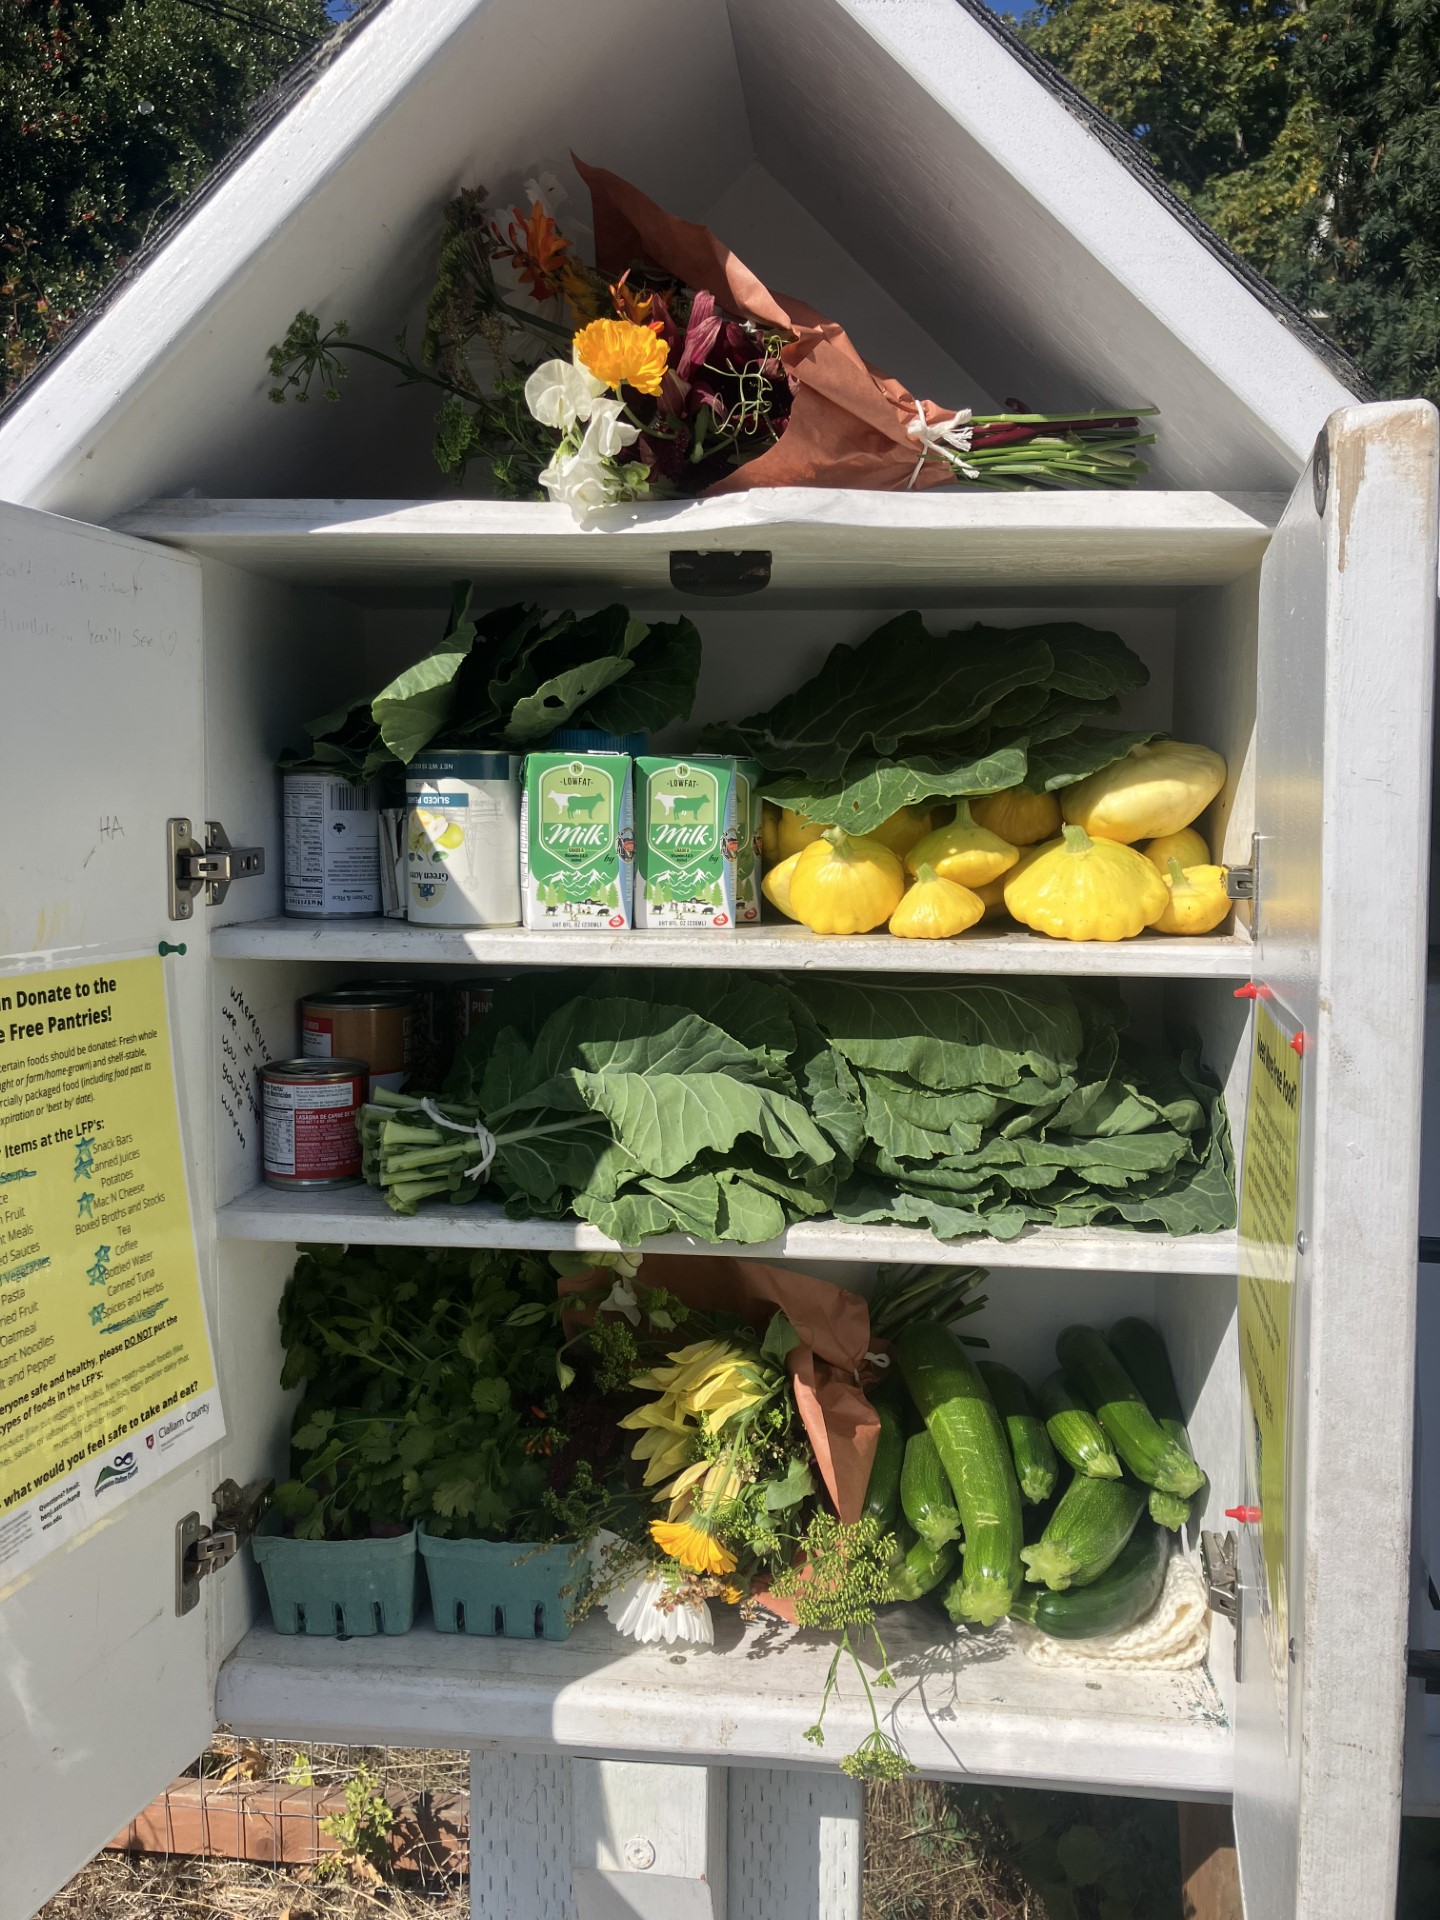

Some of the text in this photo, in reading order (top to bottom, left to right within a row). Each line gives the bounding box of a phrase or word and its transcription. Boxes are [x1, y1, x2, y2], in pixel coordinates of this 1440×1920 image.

[563, 777, 592, 787] LOWFAT
[669, 779, 697, 788] LOWFAT
[423, 796, 450, 805] SLICED
[548, 823, 604, 847] Milk
[655, 824, 710, 847] Milk
[603, 854, 615, 869] by
[708, 854, 719, 864] by
[423, 872, 449, 883] Green
[16, 977, 117, 1009] Donate to the
[9, 1005, 112, 1042] Free Pantries!
[27, 1053, 49, 1067] foods
[50, 1047, 76, 1062] should
[76, 1045, 86, 1055] be
[87, 1039, 118, 1053] donated:
[119, 1034, 137, 1047] Fresh
[138, 1029, 158, 1042] whole
[15, 1077, 25, 1087] or
[93, 1056, 107, 1068] and
[25, 1085, 61, 1102] packaged
[62, 1079, 80, 1092] food
[81, 1071, 114, 1089] (including
[113, 1067, 129, 1083] food
[130, 1064, 144, 1078] past
[0, 1108, 35, 1128] xpiration
[36, 1106, 44, 1116] or
[4, 1119, 105, 1158] Items at the LFP's:
[92, 1133, 134, 1155] Snack Bars
[89, 1148, 141, 1174] Canned Juices
[101, 1169, 134, 1189] Potatoes
[93, 1183, 146, 1210] Mac N Cheese
[5, 1206, 26, 1223] Fruit
[75, 1193, 166, 1235] Boxed Broths and Stocks
[8, 1224, 34, 1242] Meals
[117, 1224, 132, 1237] Tea
[10, 1241, 41, 1262] Sauces
[115, 1239, 139, 1257] Coffee
[104, 1251, 154, 1281] Bottled Water
[107, 1268, 156, 1297] Canned Tuna
[1, 1288, 26, 1306] Pasta
[102, 1281, 165, 1319] Spices and Herbs
[0, 1301, 40, 1328] ried Fruit
[0, 1321, 37, 1348] Oatmeal
[19, 1334, 55, 1359] Noodles
[0, 1315, 178, 1416] eryone safe and healthy, please DO NOT put the
[8, 1353, 56, 1387] and Pepper
[23, 1407, 32, 1421] of
[33, 1398, 56, 1415] foods
[57, 1390, 66, 1403] in
[66, 1383, 81, 1398] the
[81, 1370, 104, 1389] LFP's:
[185, 1403, 210, 1423] County
[3, 1380, 199, 1507] what would you feel safe to take and eat?
